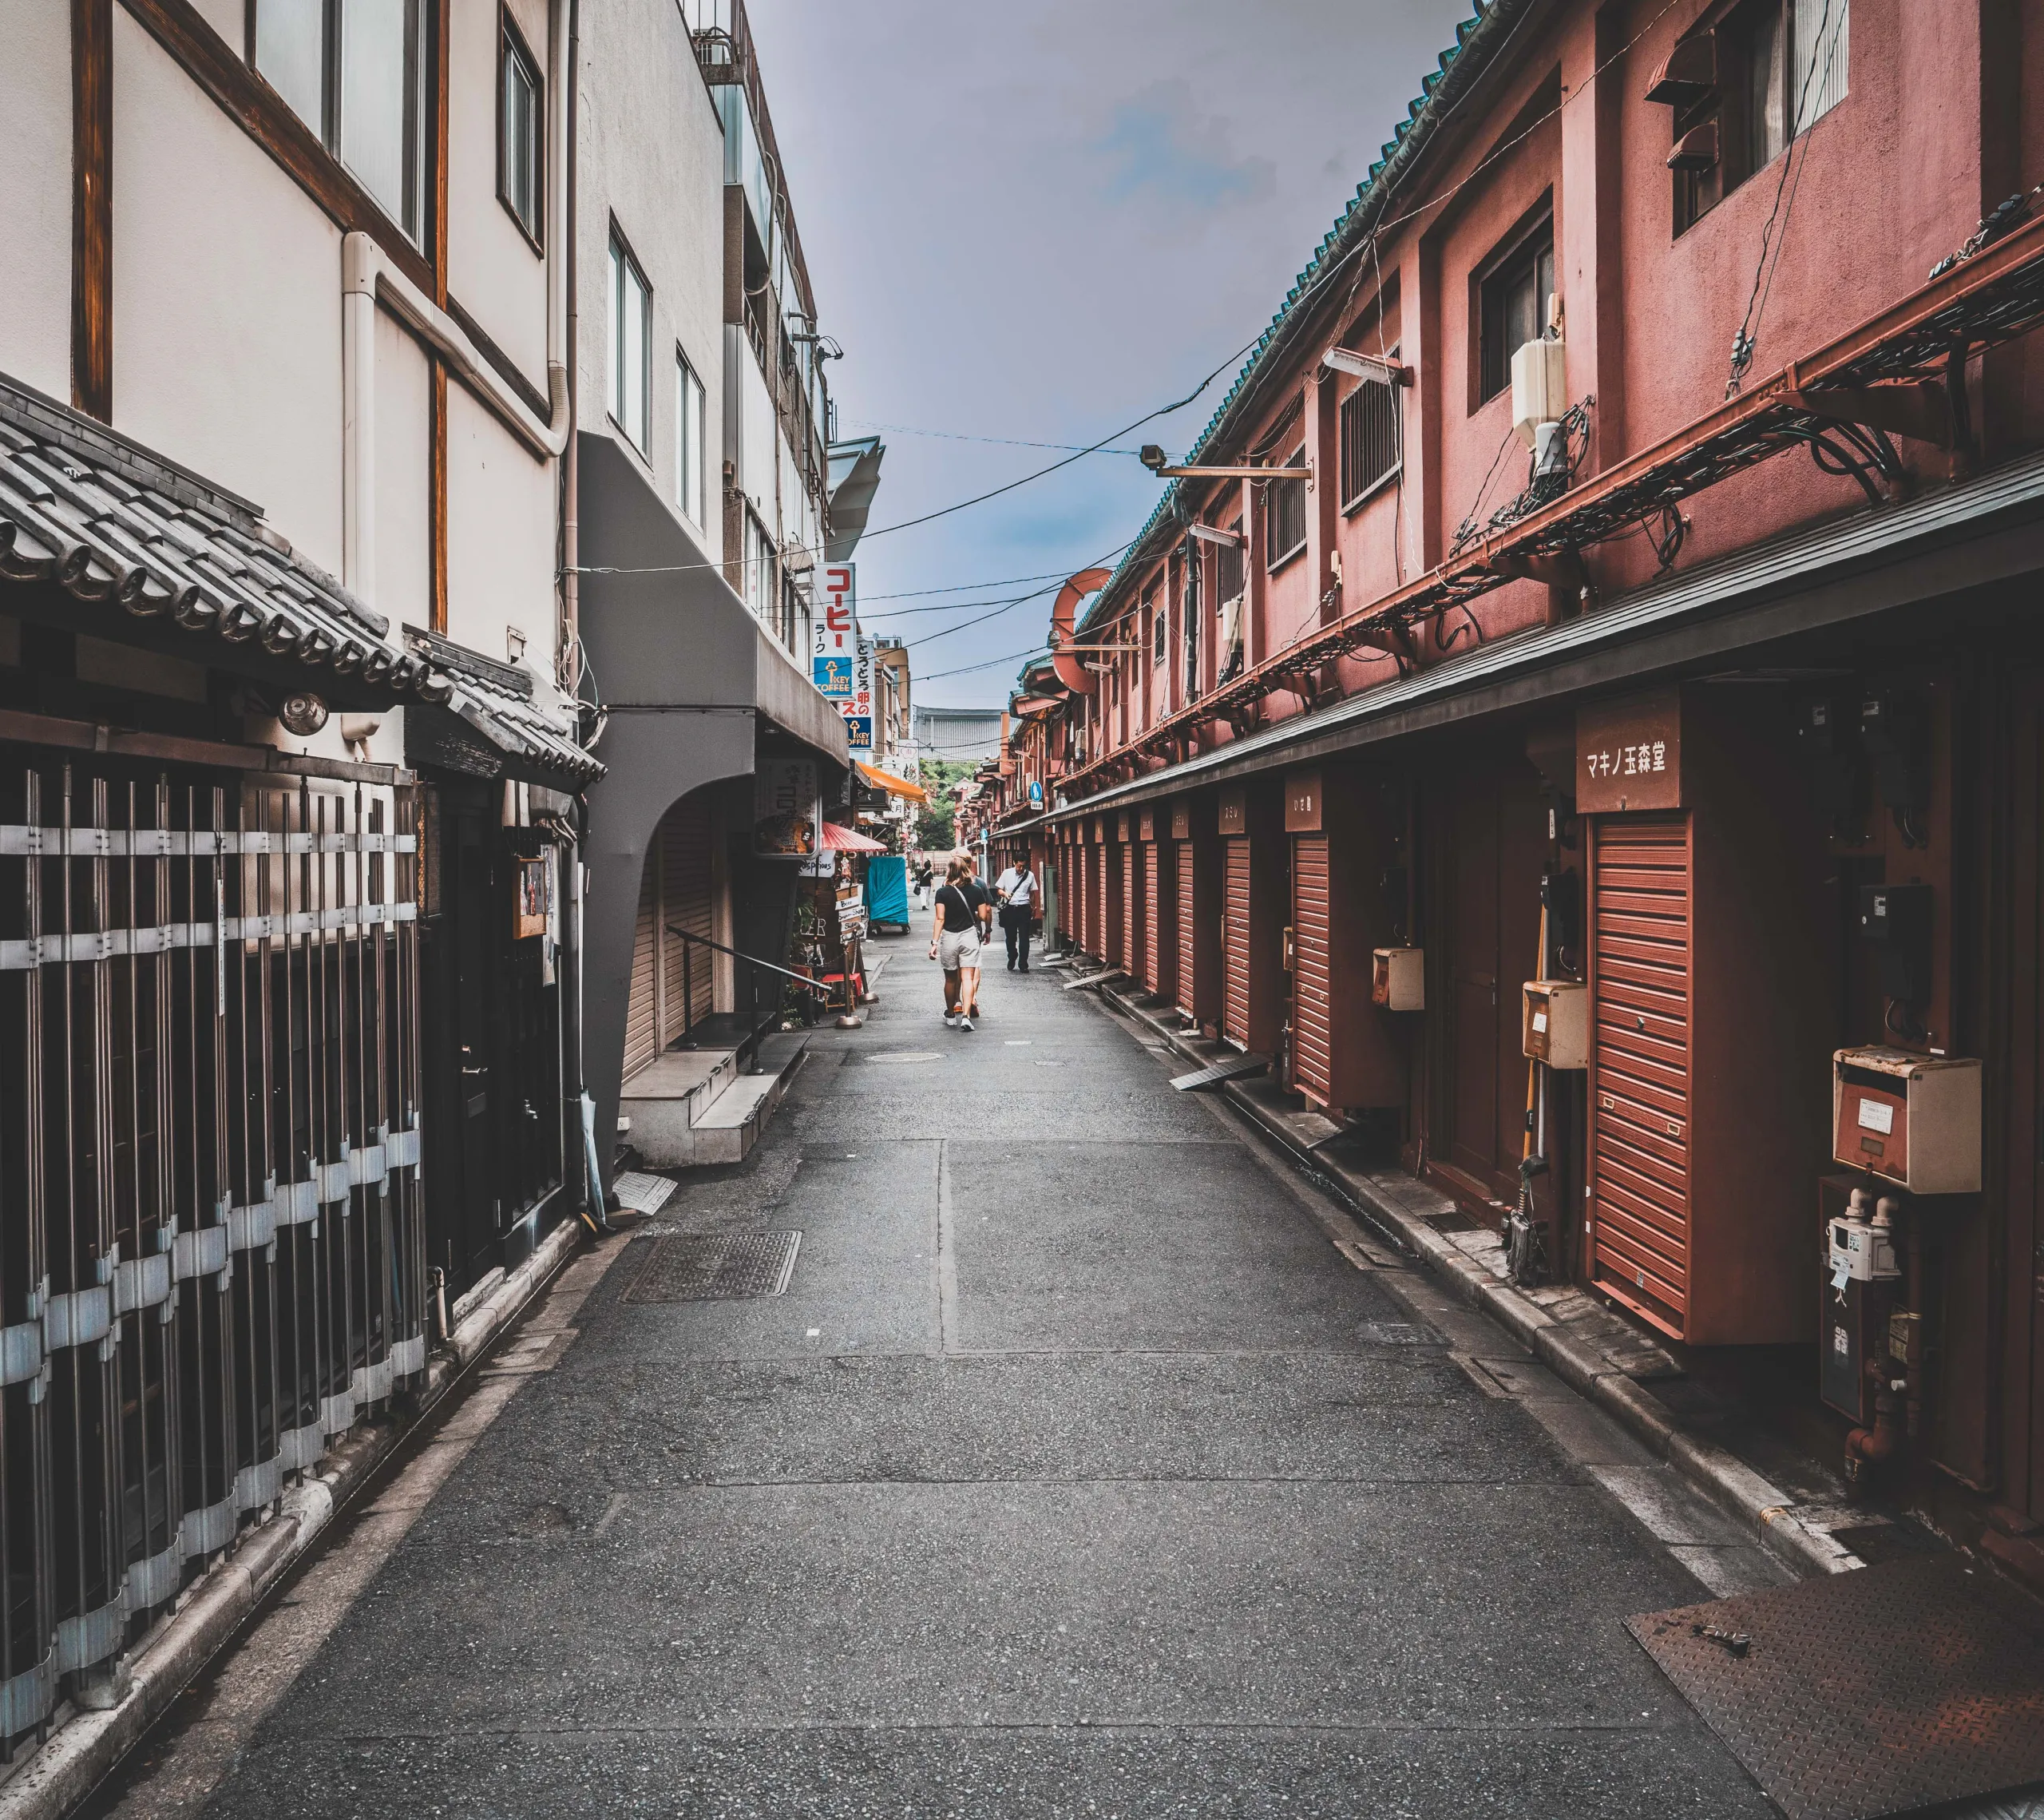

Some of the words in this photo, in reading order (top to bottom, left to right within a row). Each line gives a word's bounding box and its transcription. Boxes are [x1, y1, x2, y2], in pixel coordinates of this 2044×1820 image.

[826, 569, 851, 648] コーヒー
[815, 624, 826, 653] ラーク
[1586, 740, 1666, 779] マキノ玉森堂
[1225, 806, 1238, 819] スミレ
